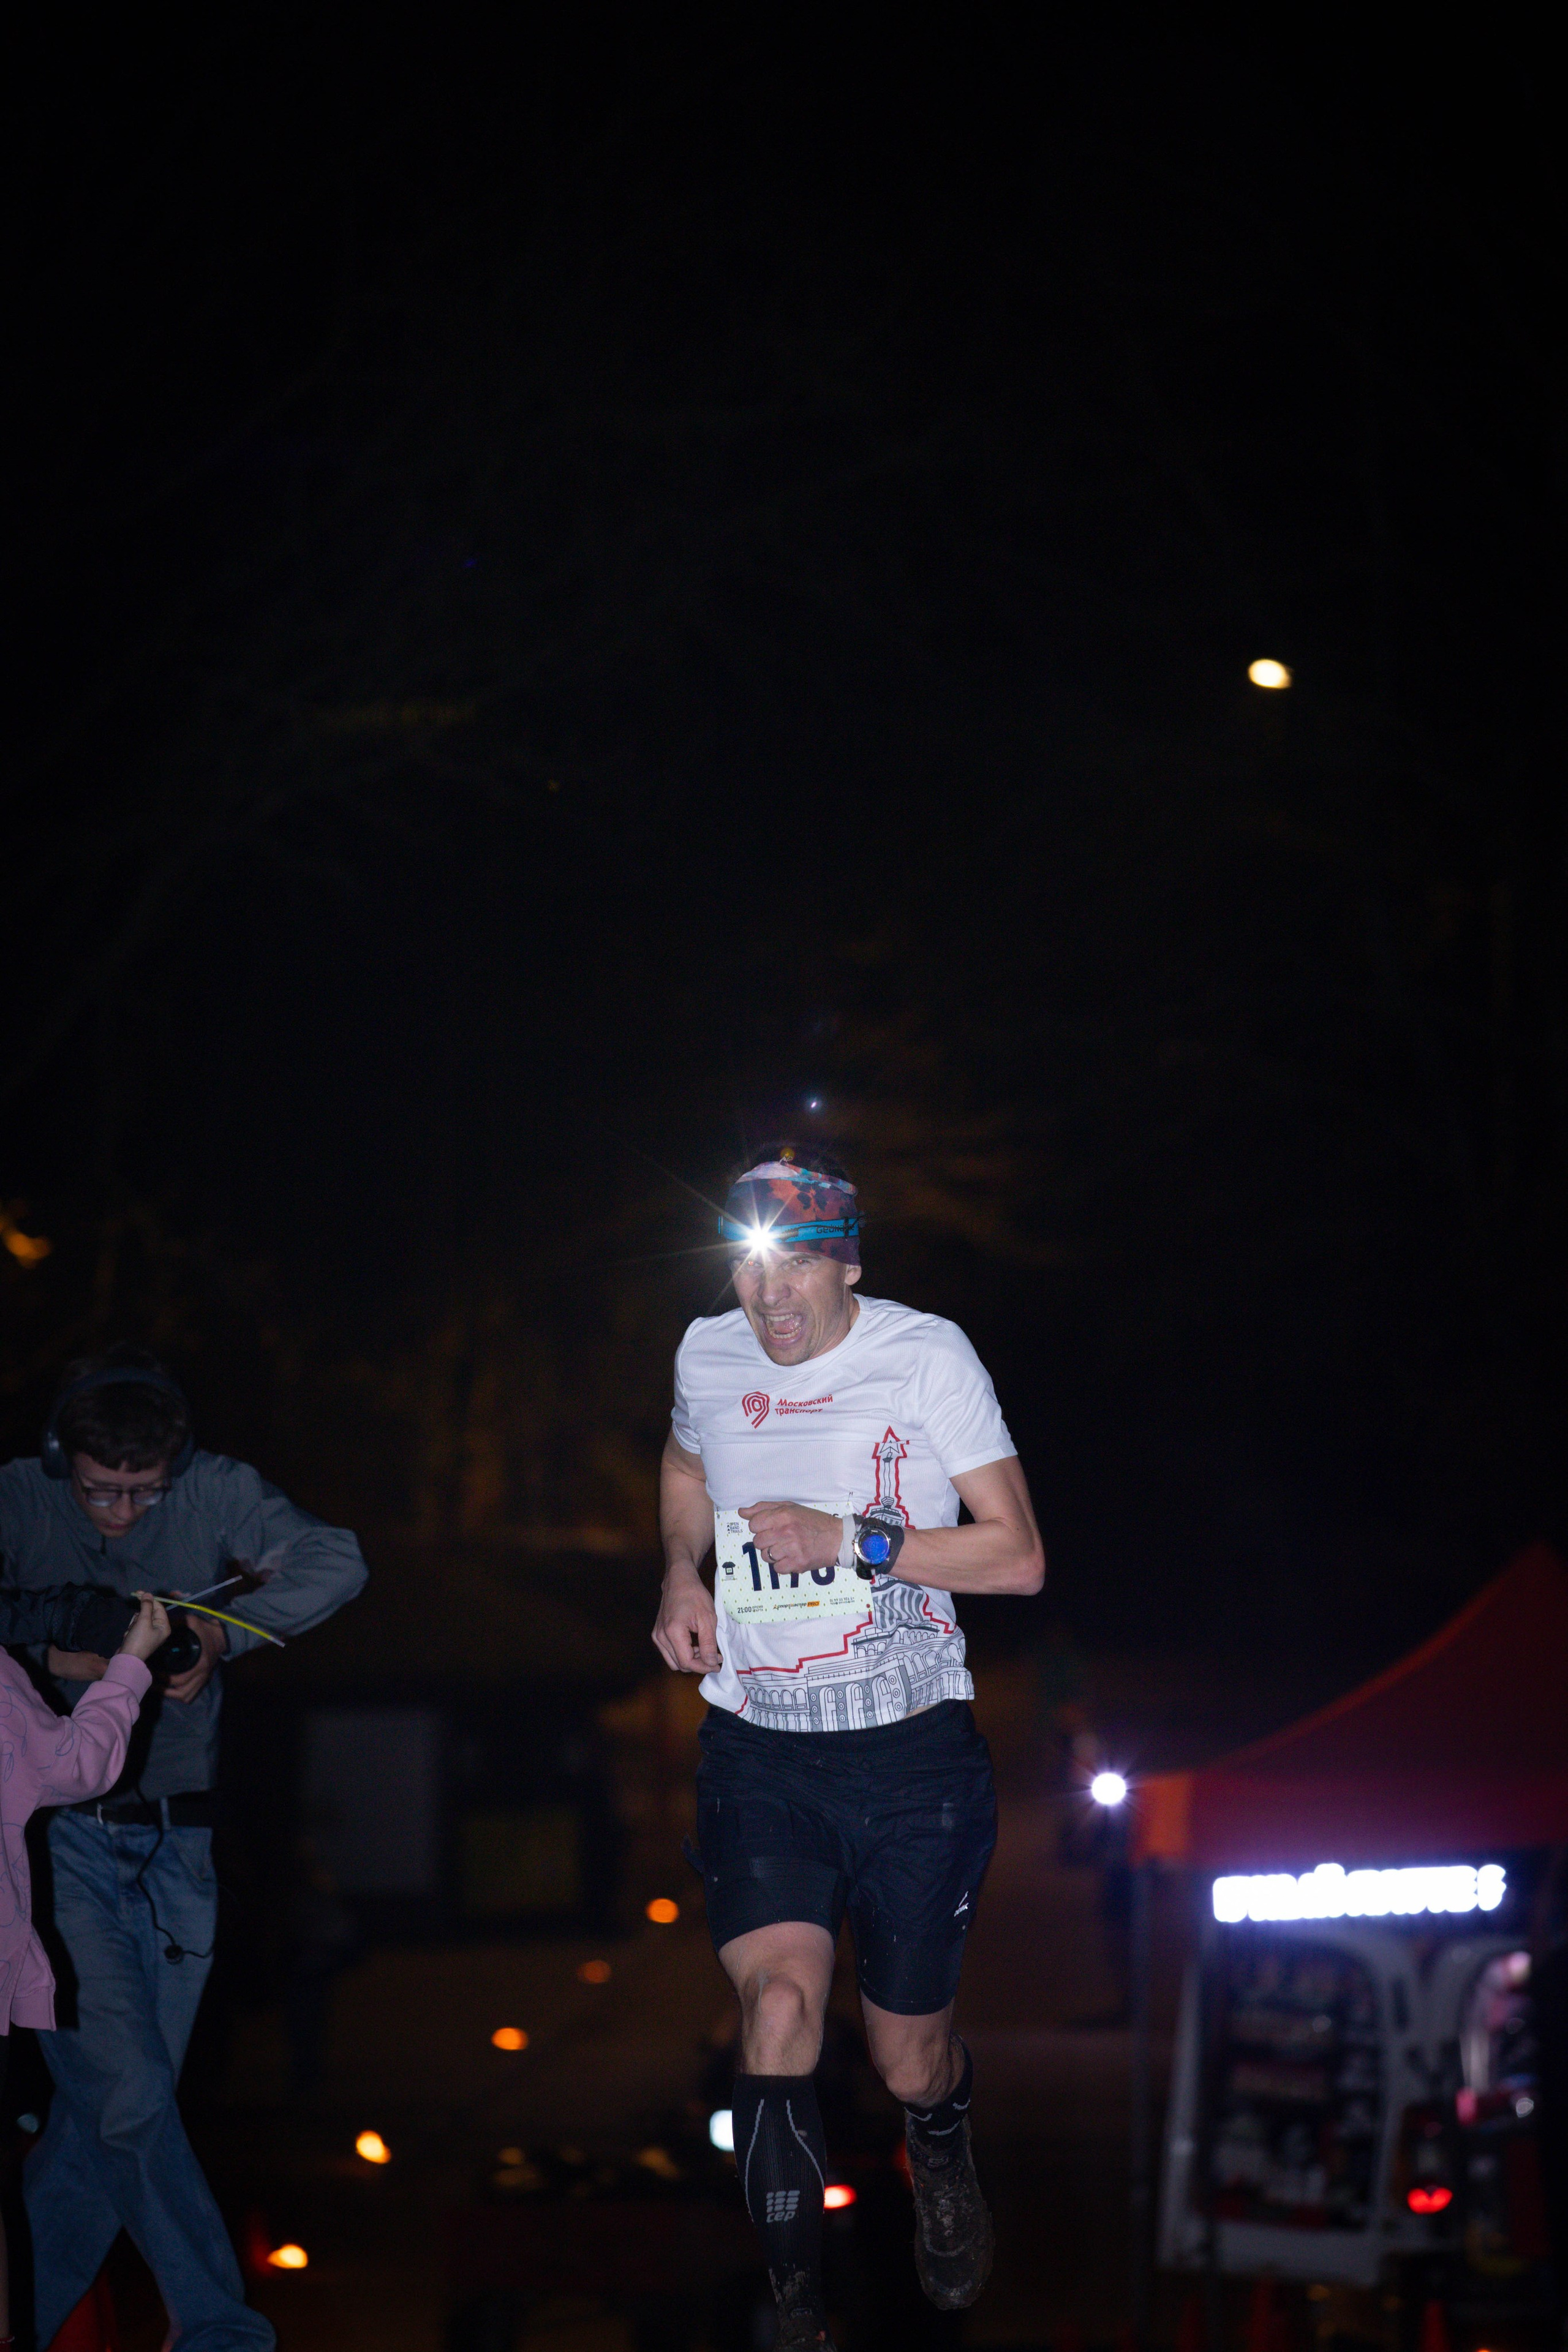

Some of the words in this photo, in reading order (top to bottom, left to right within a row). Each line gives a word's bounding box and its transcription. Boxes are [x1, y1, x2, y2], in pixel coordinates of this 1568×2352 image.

[777, 1394, 833, 1407] Московский
[775, 1407, 823, 1415] транспорт
[766, 2211, 796, 2223] cep
